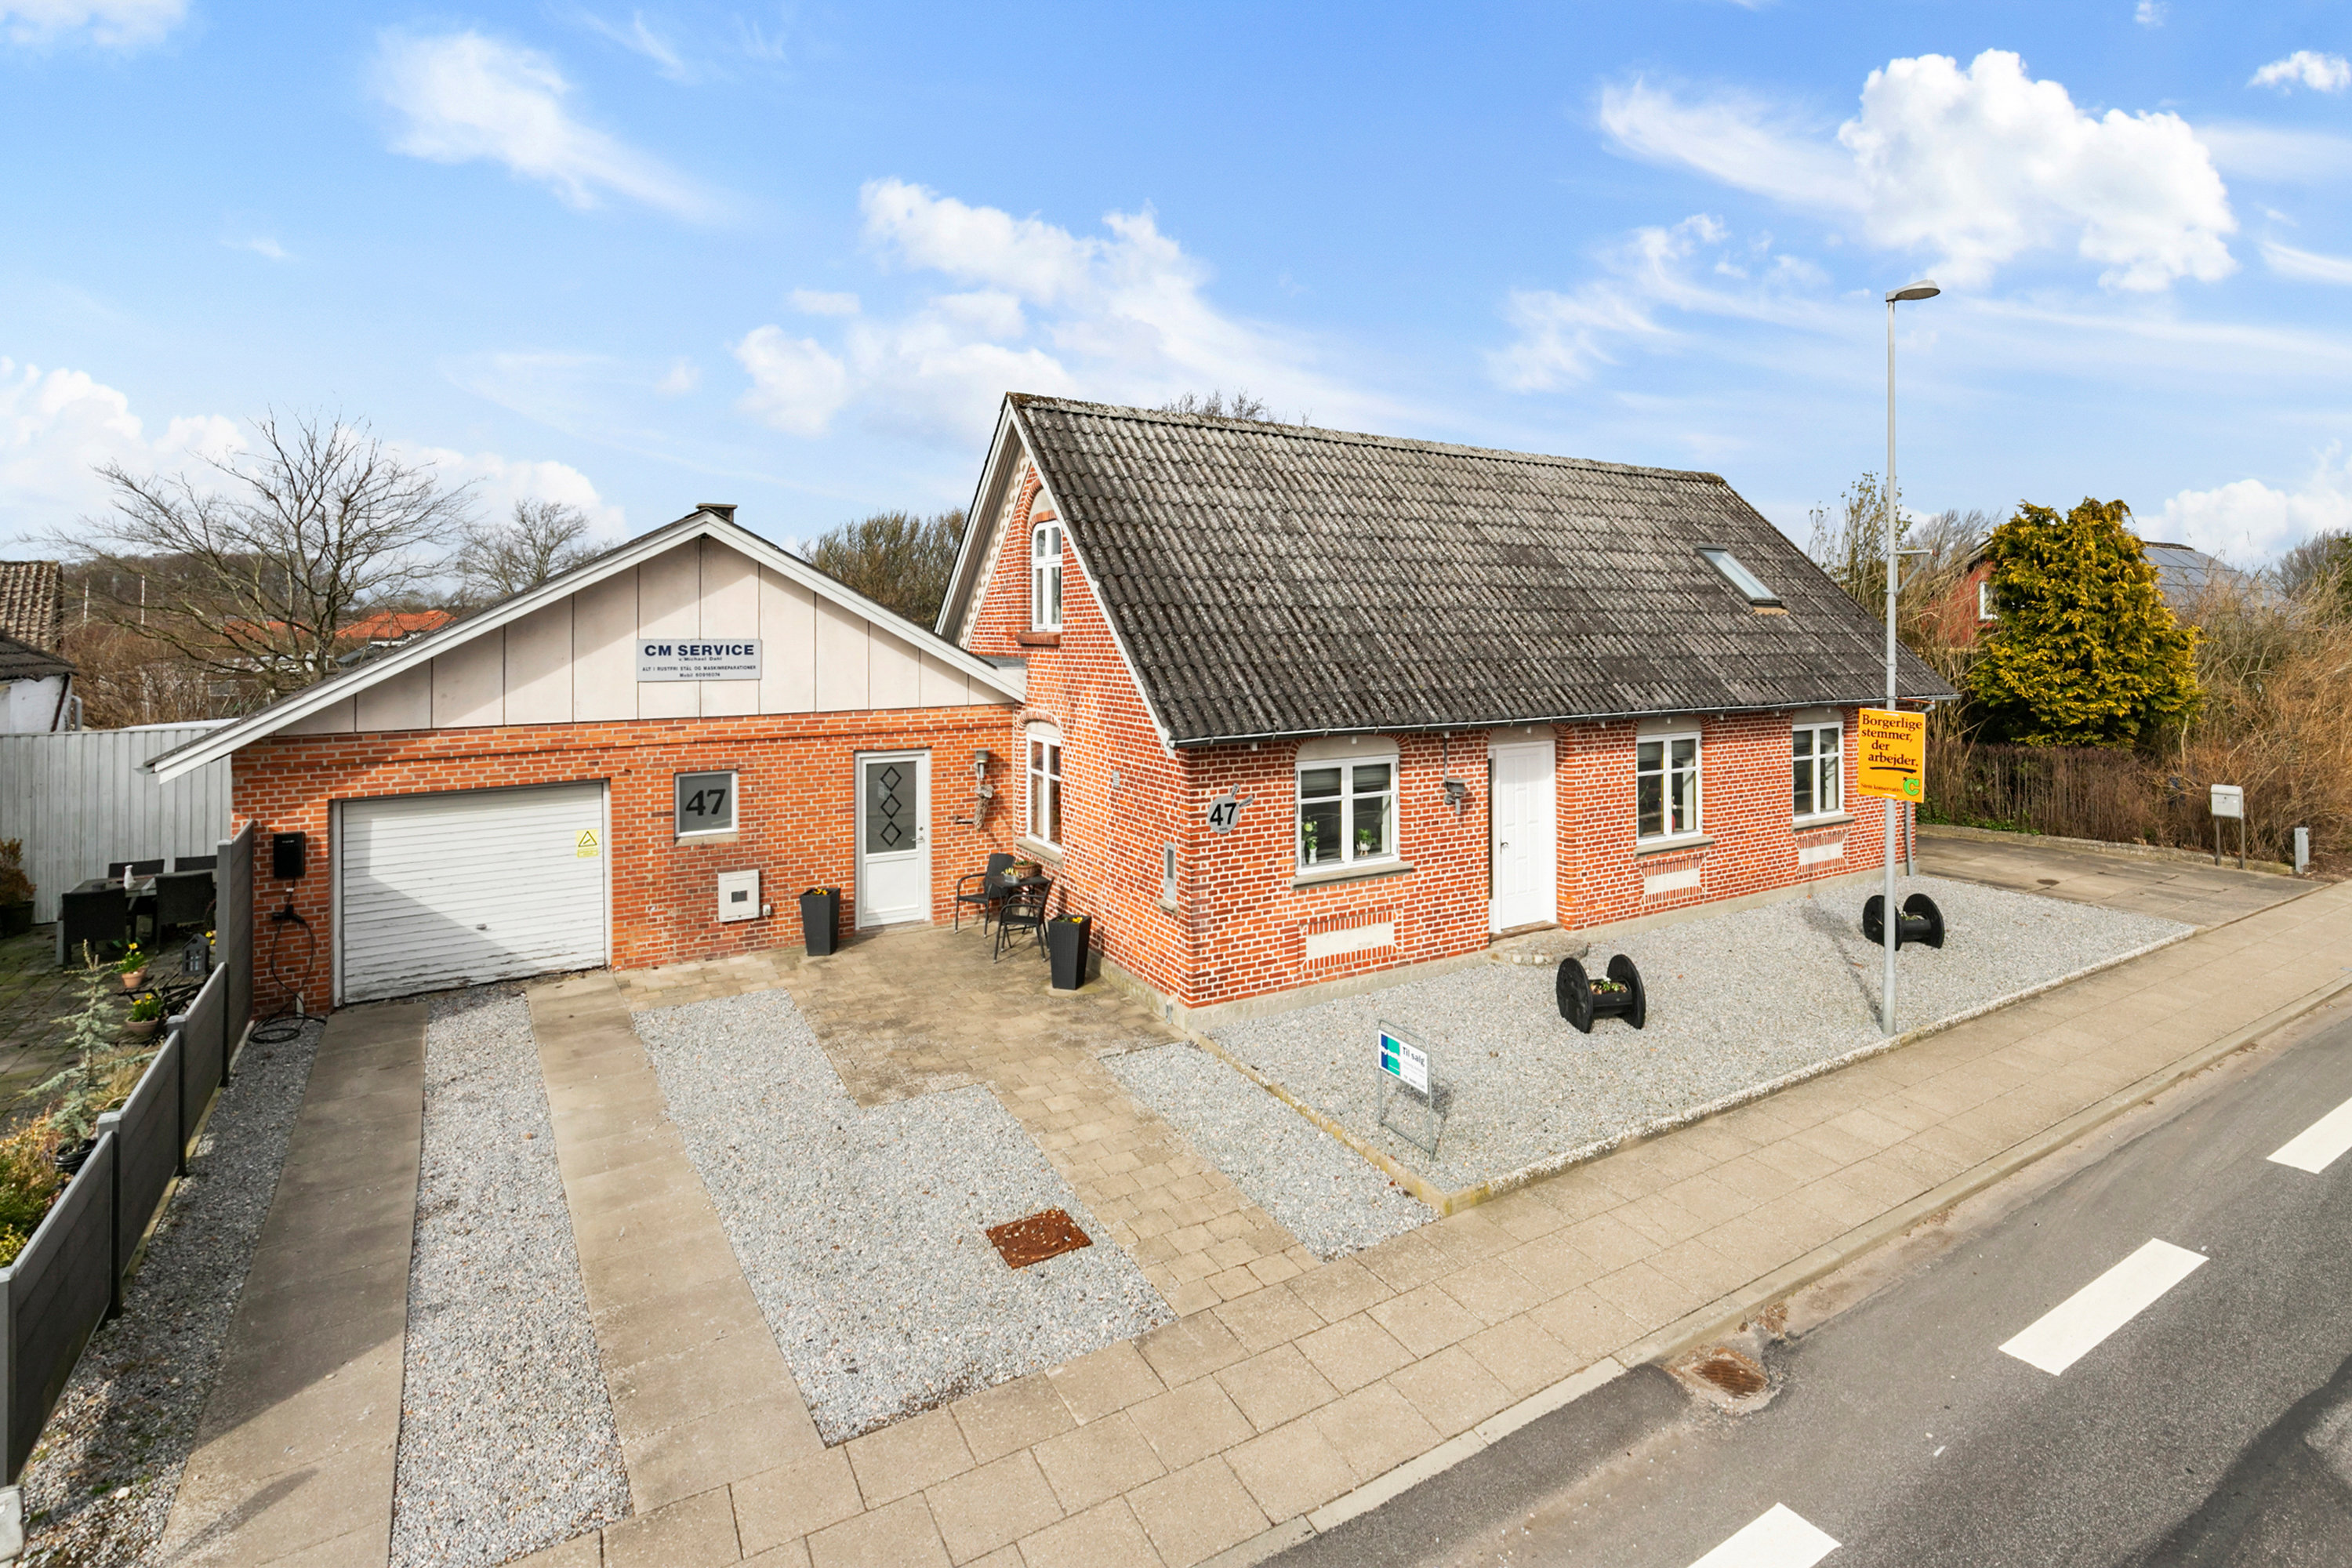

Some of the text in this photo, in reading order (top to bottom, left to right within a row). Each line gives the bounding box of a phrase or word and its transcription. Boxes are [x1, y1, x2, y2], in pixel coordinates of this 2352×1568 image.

[644, 644, 754, 656] CM SERVICE
[1862, 714, 1922, 731] Borgerlige
[1861, 728, 1913, 743] stemmer,
[1871, 739, 1890, 750] der
[1867, 752, 1918, 767] arbejder.
[685, 789, 726, 816] 47
[1210, 802, 1236, 826] 47
[1411, 1053, 1425, 1067] salg
